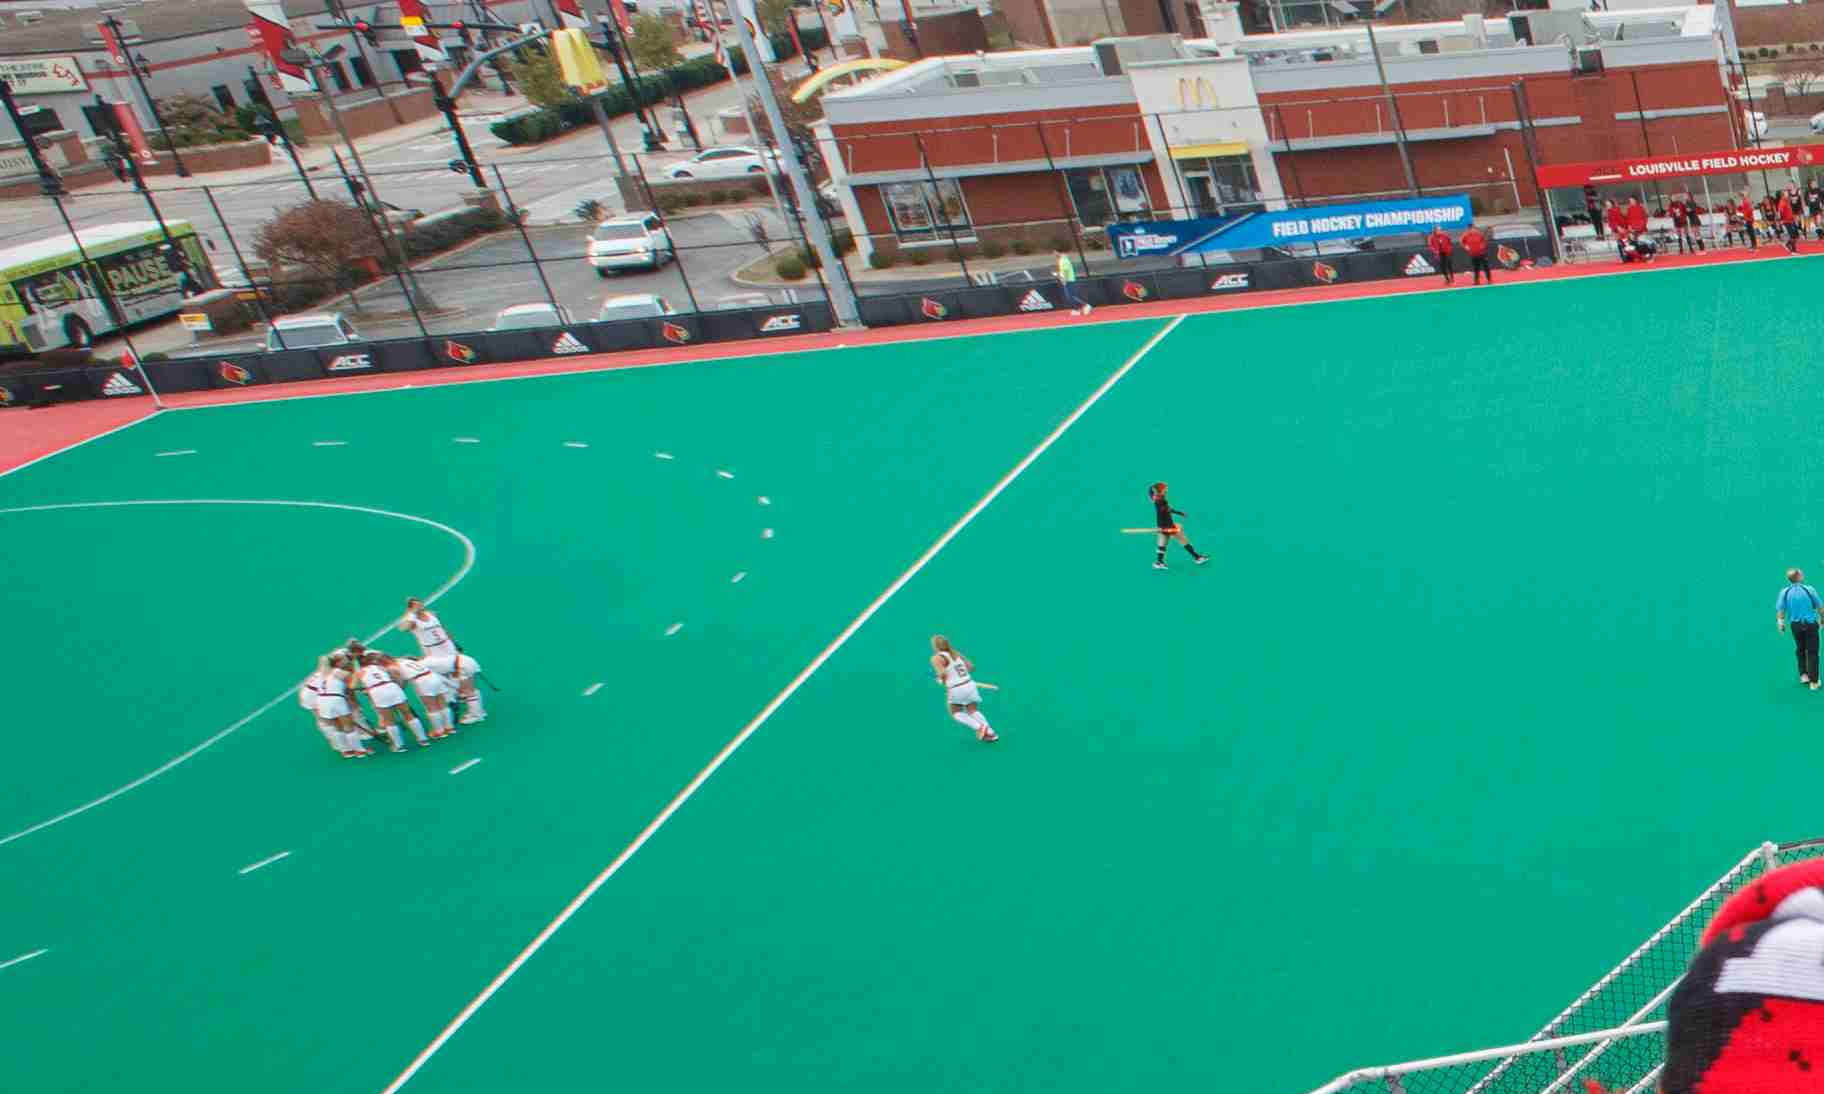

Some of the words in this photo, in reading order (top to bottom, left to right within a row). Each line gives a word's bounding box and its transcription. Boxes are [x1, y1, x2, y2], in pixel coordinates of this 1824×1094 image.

[1629, 159, 1700, 177] LOUISVILLE
[1701, 155, 1738, 171] FIELD
[1739, 151, 1791, 167] HOCKEY
[1271, 219, 1309, 237] FIELD
[1311, 214, 1362, 235] HOCKEY
[1365, 206, 1465, 229] CHAMPIONSHIP
[1211, 273, 1249, 290] ACC
[760, 314, 801, 332] ACC
[329, 354, 374, 371] ACC
